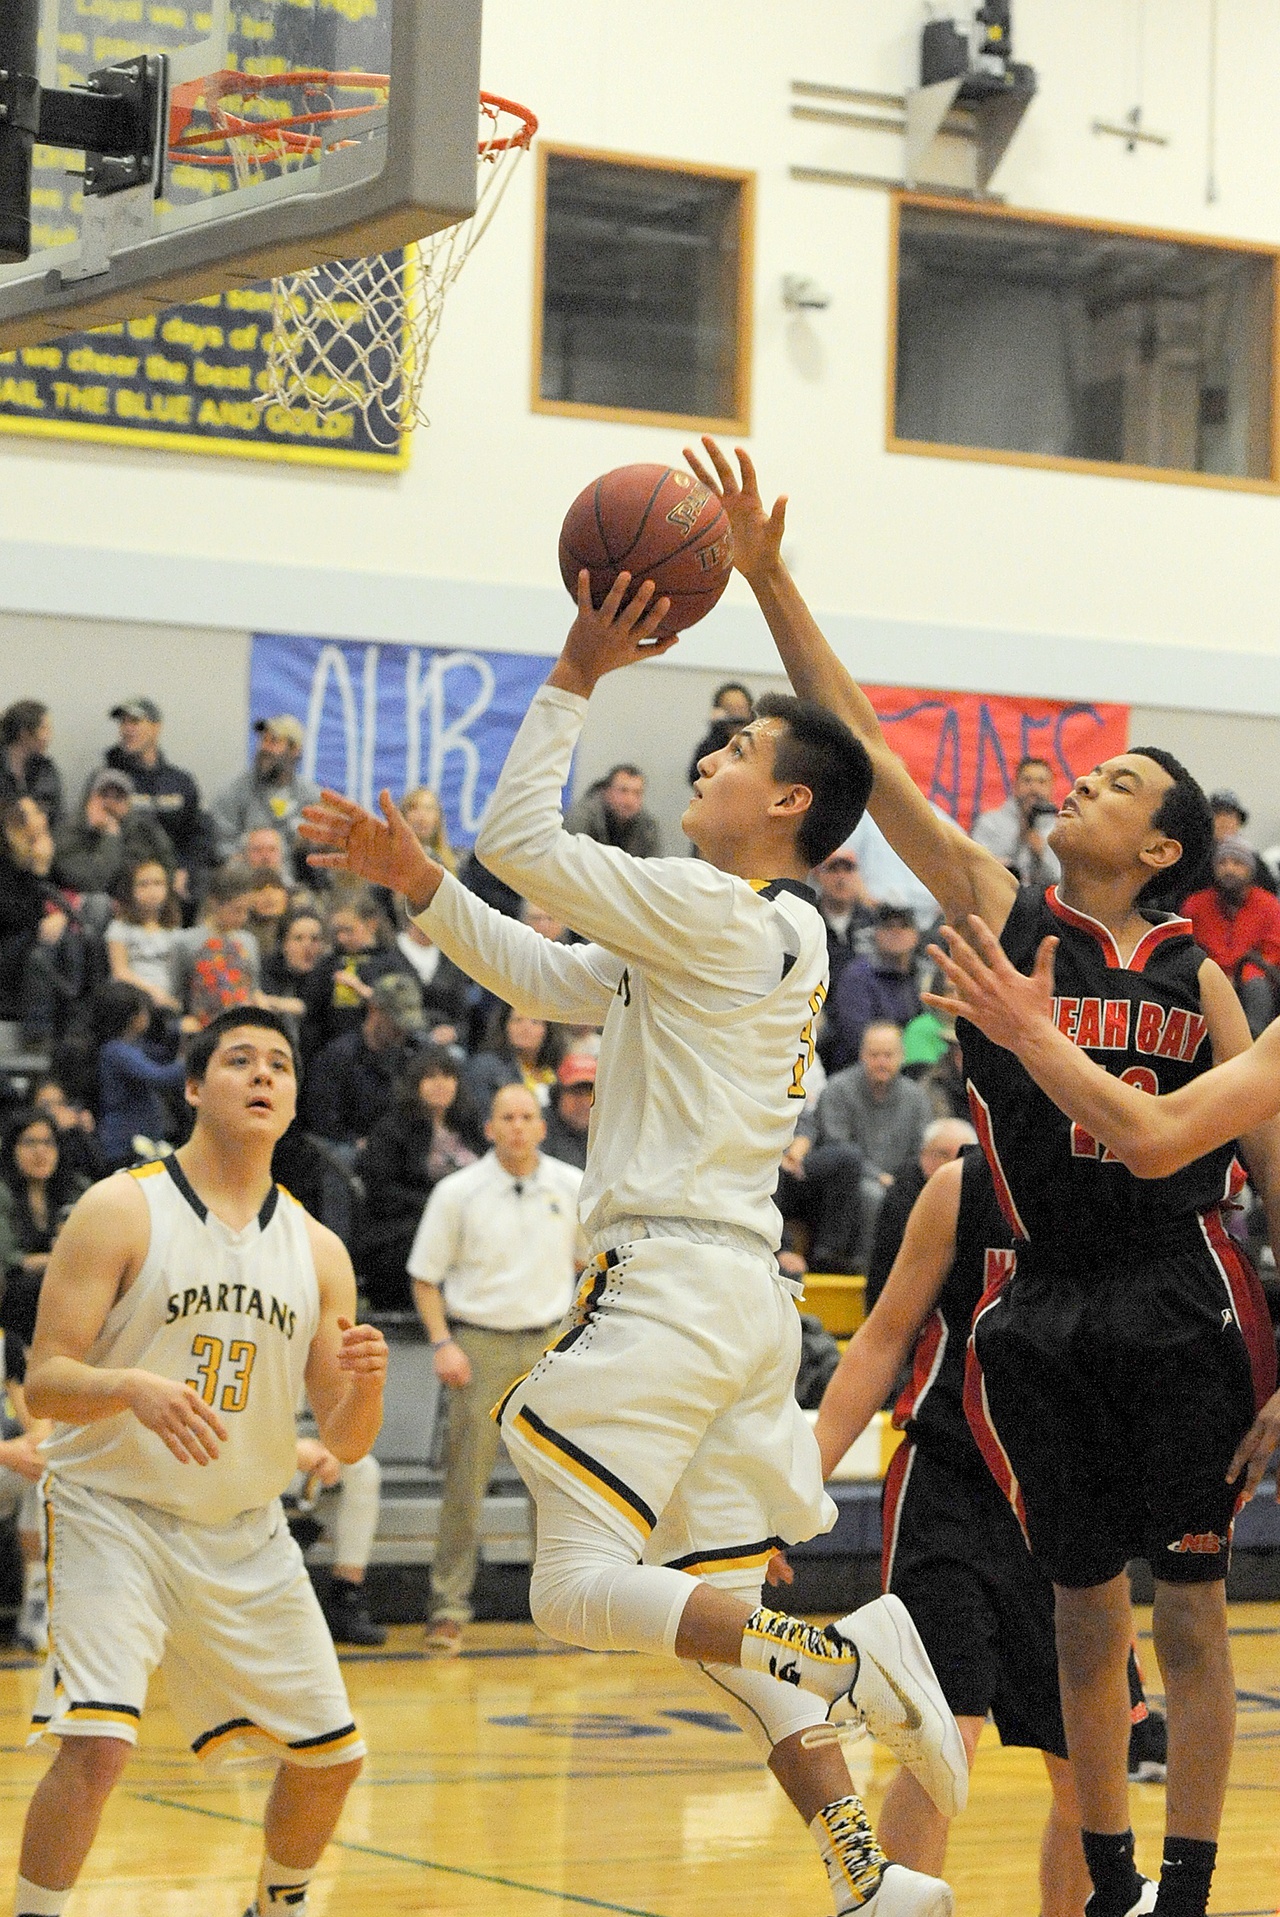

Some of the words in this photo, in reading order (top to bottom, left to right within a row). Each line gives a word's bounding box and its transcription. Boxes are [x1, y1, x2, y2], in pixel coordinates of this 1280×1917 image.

[145, 354, 188, 384] the
[0, 376, 44, 410] AIL
[53, 381, 109, 415] THE
[115, 387, 192, 425] BLUE
[198, 397, 260, 431] AND
[1051, 997, 1131, 1050] EAH
[1136, 1001, 1208, 1063] BAY
[164, 1283, 297, 1341] SPARTANS
[185, 1333, 258, 1413] 33
